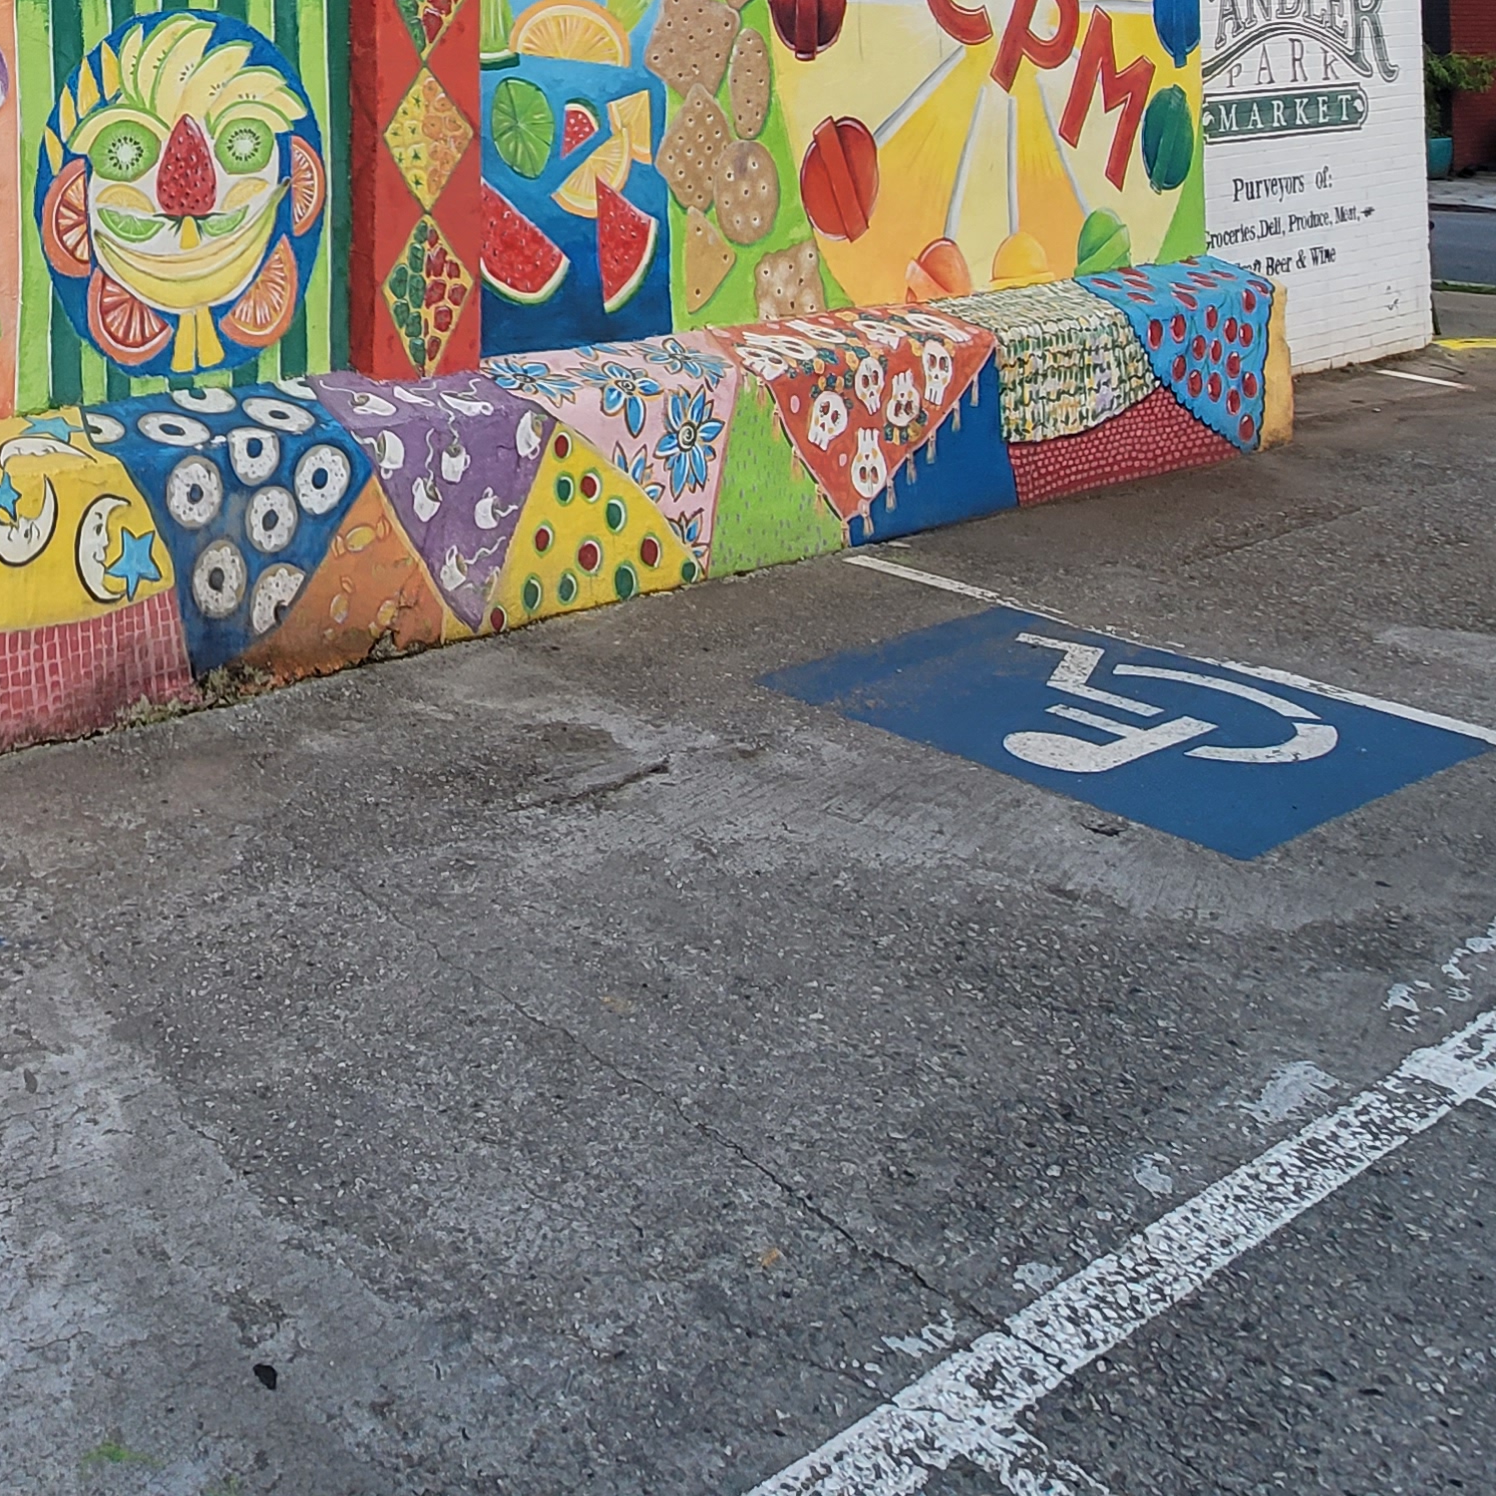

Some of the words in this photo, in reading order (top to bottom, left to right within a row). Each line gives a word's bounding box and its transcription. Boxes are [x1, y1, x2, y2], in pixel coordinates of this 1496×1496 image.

[1226, 38, 1340, 88] PARK
[1217, 93, 1353, 134] MARKET
[1232, 174, 1304, 203] Purveyors
[1315, 165, 1333, 190] of:
[1265, 256, 1292, 277] Beer
[1296, 249, 1306, 269] &
[1309, 245, 1337, 266] Wine
